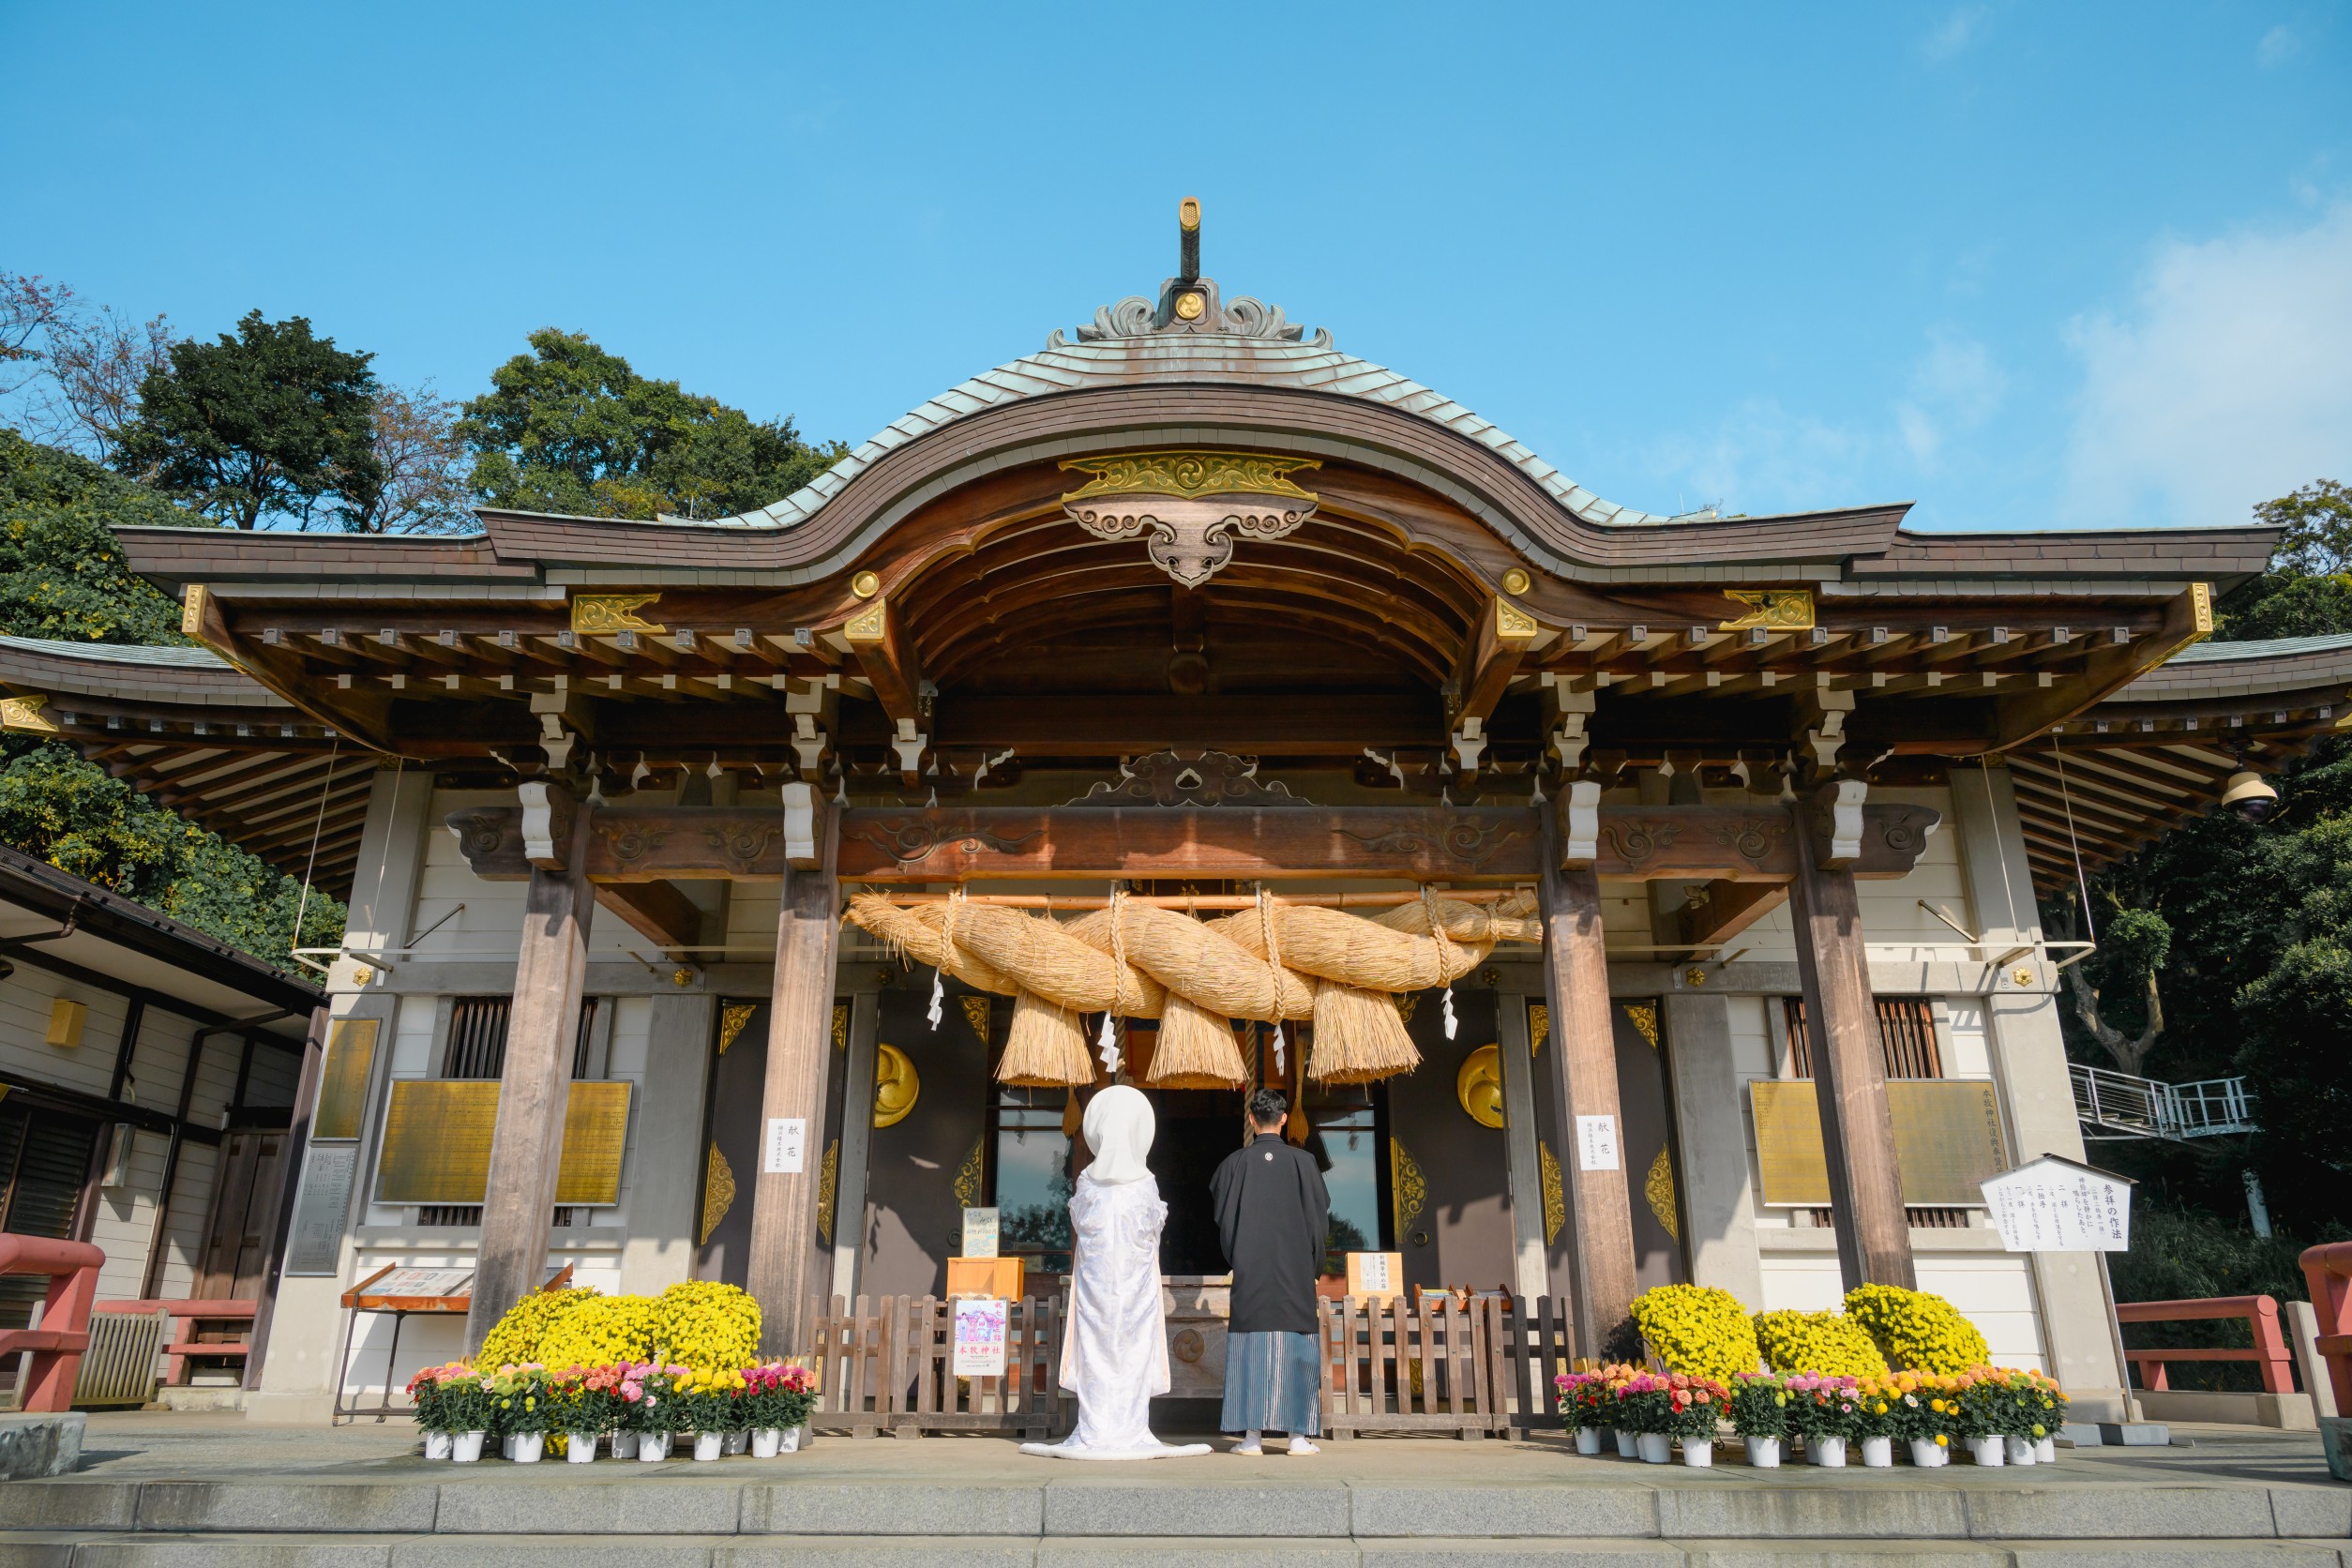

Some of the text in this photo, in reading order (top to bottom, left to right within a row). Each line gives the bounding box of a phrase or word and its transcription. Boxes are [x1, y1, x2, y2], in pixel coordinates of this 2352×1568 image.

[788, 1125, 799, 1157] 献花
[1597, 1122, 1610, 1154] 献花
[2036, 1184, 2046, 1209] 二拍手
[2103, 1184, 2122, 1240] 参拝の作法
[958, 1345, 1001, 1355] 本牧神社
